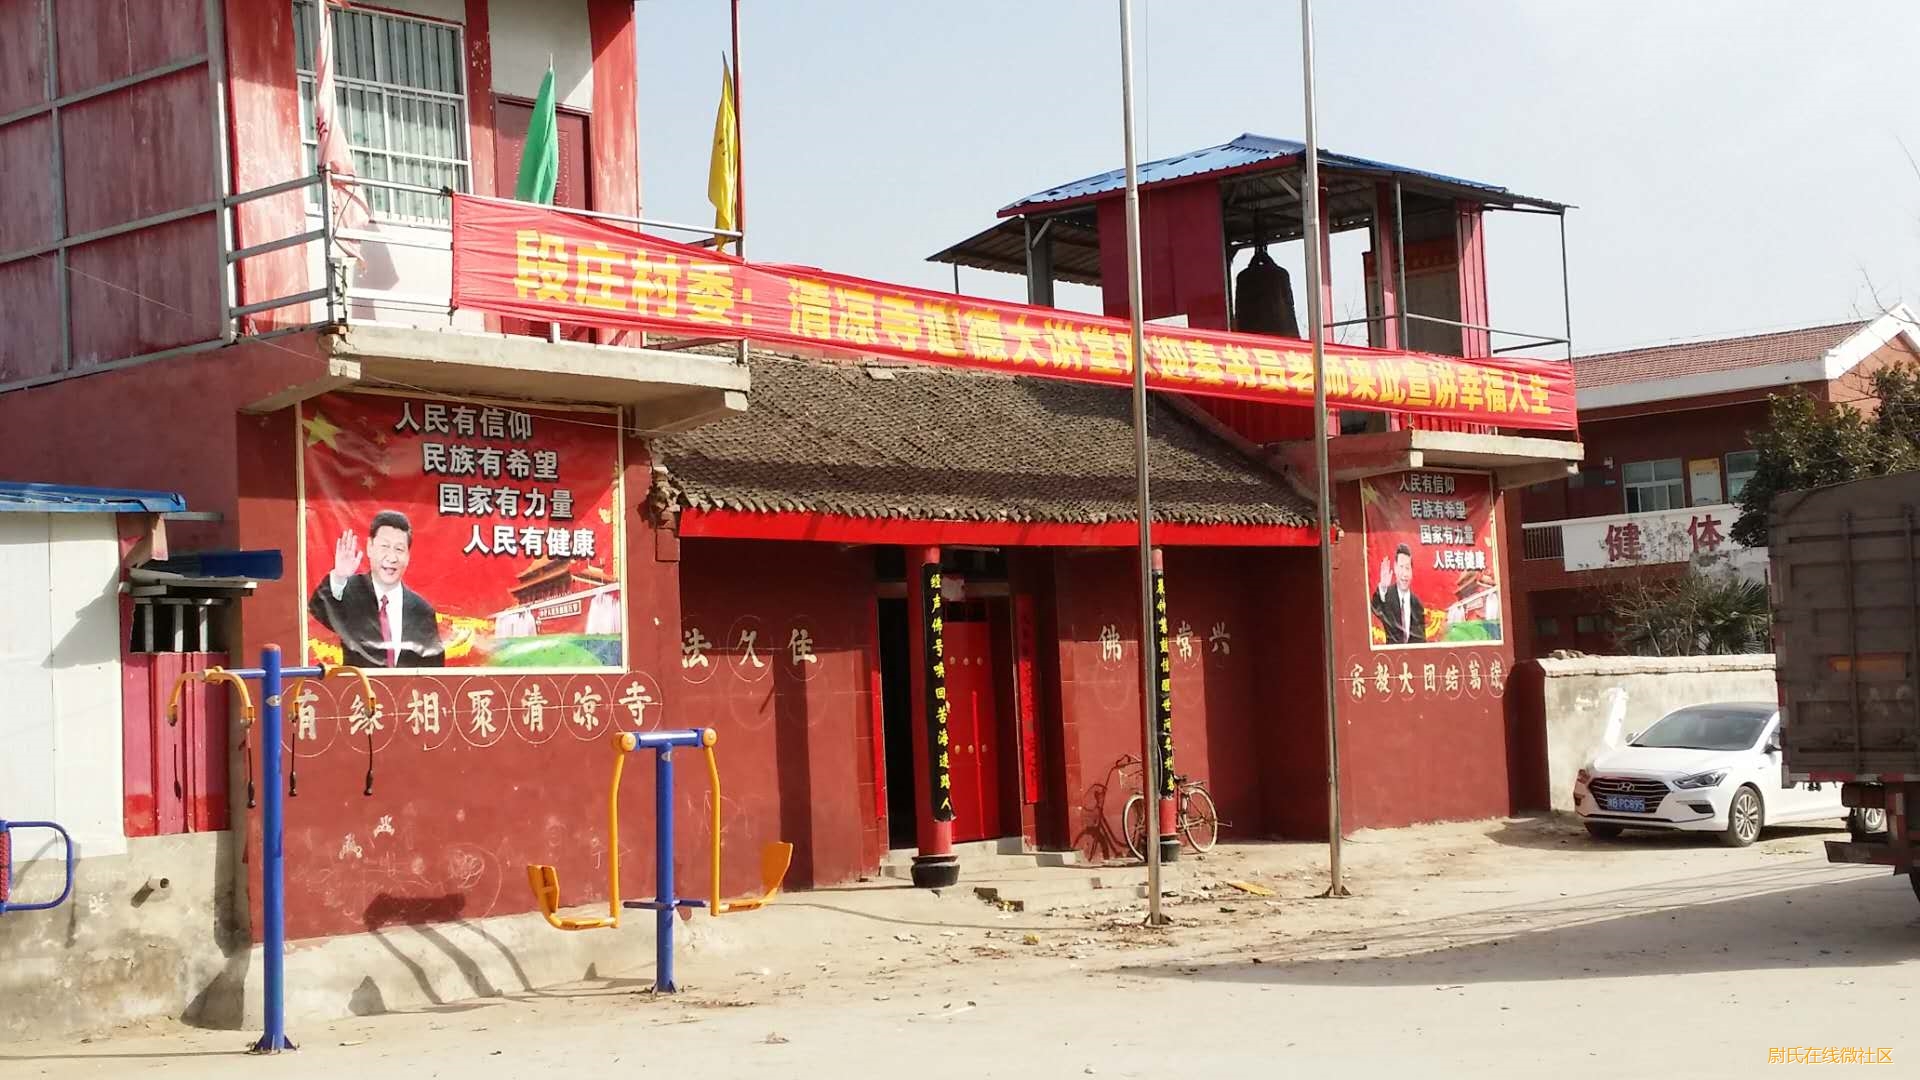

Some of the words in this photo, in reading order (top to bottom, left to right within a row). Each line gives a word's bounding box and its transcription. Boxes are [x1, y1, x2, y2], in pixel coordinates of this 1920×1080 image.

[395, 402, 532, 440] 人民有信仰
[422, 443, 559, 480] 民族有希望
[1399, 474, 1455, 494] 人民有信仰
[439, 483, 574, 520] 国家有力量
[1411, 500, 1467, 520] 民族有希望
[463, 525, 596, 558] 人民有健康
[1420, 524, 1475, 545] 国家有力量
[1433, 551, 1486, 570] 人民有健康
[292, 680, 652, 740] 有缘相聚清凉寺
